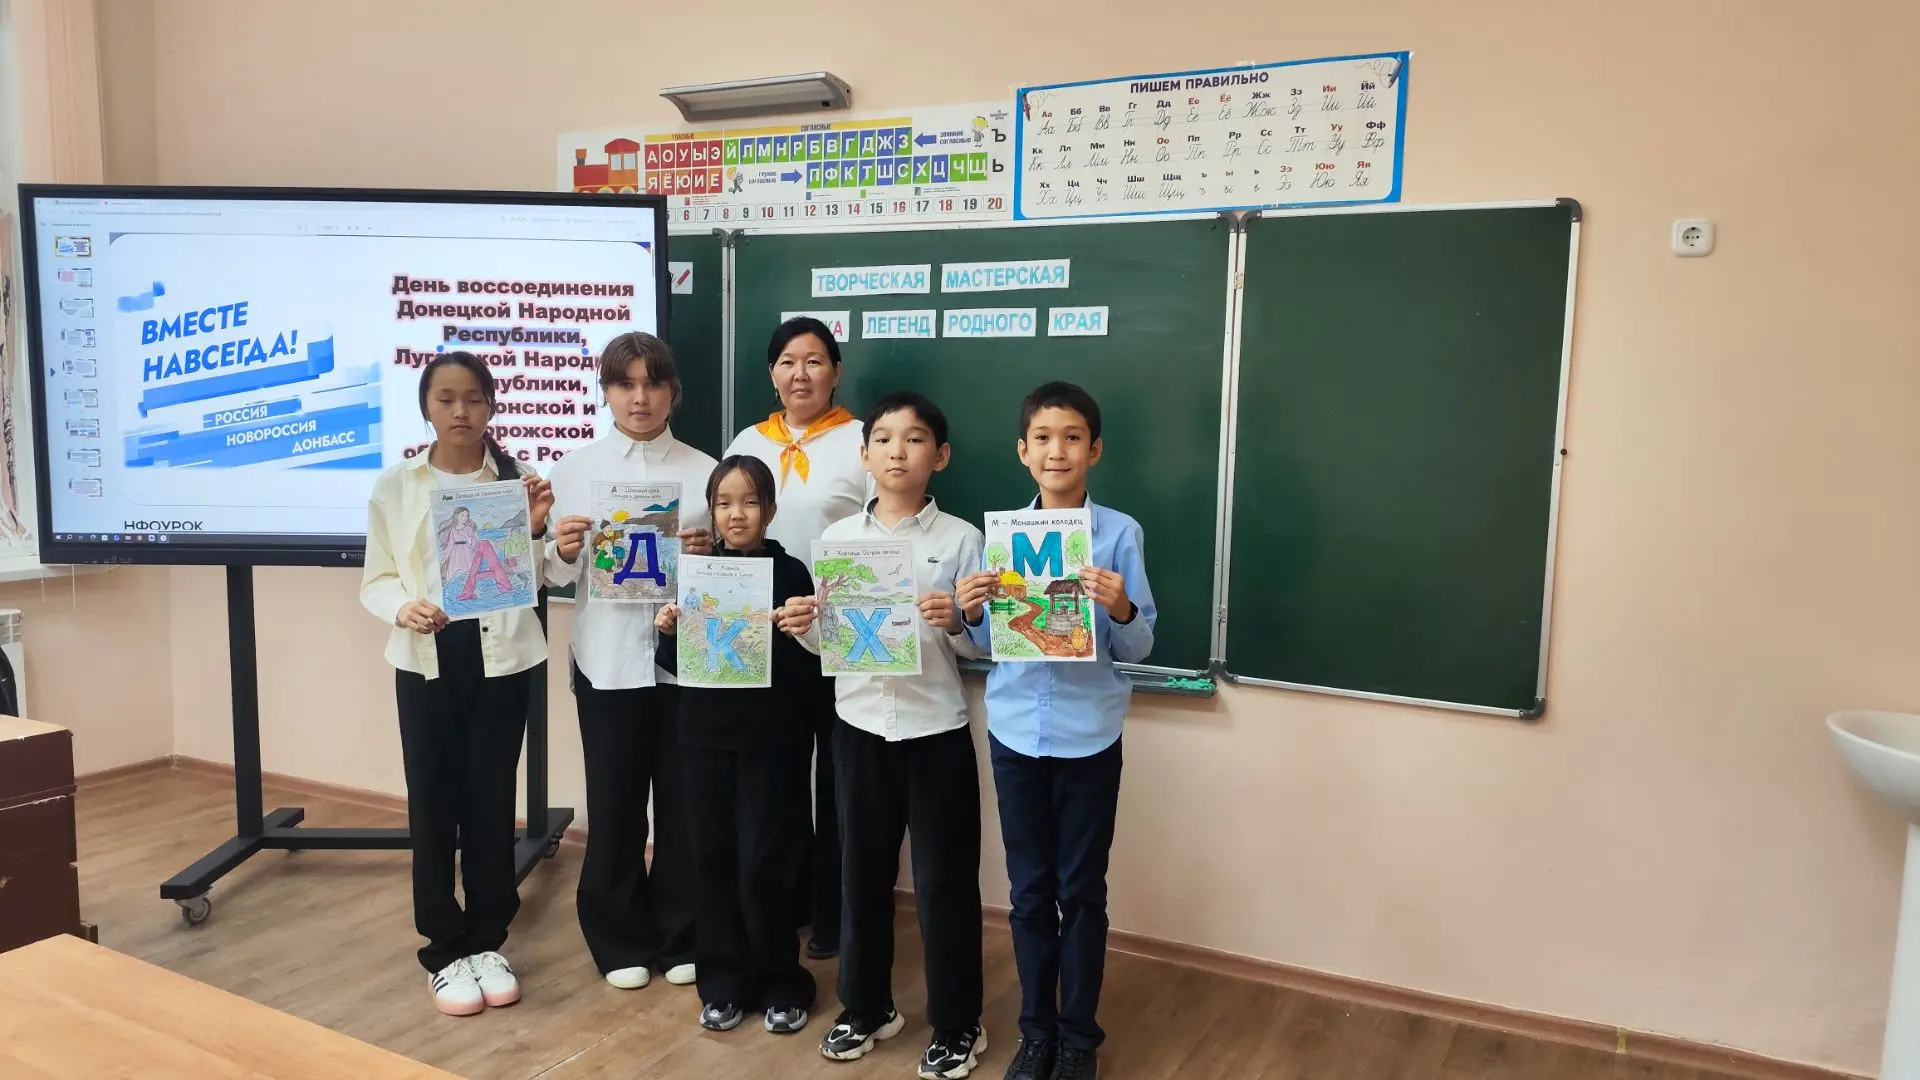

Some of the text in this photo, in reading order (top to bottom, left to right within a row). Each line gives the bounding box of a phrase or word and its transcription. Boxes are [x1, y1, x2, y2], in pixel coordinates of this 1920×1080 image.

[1130, 72, 1269, 93] ПИШЕМ ПРАВИЛЬНО
[1070, 108, 1082, 116] Бб
[1128, 102, 1137, 110] Гг
[1156, 100, 1171, 108] Дд
[1220, 94, 1231, 102] Ёё
[1252, 91, 1271, 99] Жж
[1290, 88, 1303, 96] Зз
[1323, 85, 1337, 93] Ии
[1361, 81, 1375, 90] Йй
[991, 128, 1007, 143] Ъ
[1090, 142, 1105, 150] Мм
[1157, 137, 1170, 145] Оо
[1229, 132, 1242, 140] Рр
[1260, 129, 1272, 137] Сс
[1294, 126, 1306, 134] Тт
[1330, 123, 1343, 132] Уу
[1365, 121, 1386, 132] Фф
[992, 159, 1004, 173] Ь
[1039, 182, 1050, 190] Хх
[1067, 180, 1081, 188] Цц
[1127, 175, 1145, 183] Шш
[1163, 173, 1182, 182] Щщ
[1280, 165, 1292, 173] Ээ
[1315, 162, 1335, 170] Юю
[1357, 160, 1371, 169] Яя
[683, 210, 690, 221] 6
[703, 209, 710, 220] 7
[722, 208, 729, 219] 8
[742, 207, 749, 218] 9
[761, 206, 774, 218] 10
[783, 206, 795, 217] 11
[804, 205, 816, 217] 12
[825, 204, 838, 216] 13
[847, 203, 860, 215] 14
[870, 202, 883, 214] 15
[892, 202, 906, 213] 16
[916, 201, 929, 213] 17
[939, 199, 953, 211] 18
[963, 198, 977, 210] 19
[987, 197, 1003, 209] 20
[392, 275, 635, 298] День воссоединения
[816, 265, 1066, 292] ТВОРЧЕСКАЯ МАСТЕРСКАЯ
[141, 301, 249, 346] ВМЕСТЕ
[397, 301, 631, 323] Донецкой Народной
[866, 316, 931, 336] ЛЕГЕНД
[948, 312, 1033, 335] РОДНОГО
[1053, 311, 1101, 331] КРАЯ
[443, 325, 587, 348] Республики,
[143, 330, 298, 382] НАВСЕГДА!
[394, 347, 517, 369] Лугкой
[215, 405, 268, 426] РОССИЯ
[583, 403, 596, 415] и
[226, 420, 317, 447] НОВОРОССИЯ
[292, 431, 356, 455] ДОНБАСС
[517, 449, 529, 461] с
[124, 520, 204, 531] НФОУРОК
[1011, 518, 1049, 527] Монашкин
[1051, 518, 1084, 526] колодец
[613, 533, 667, 587] Д
[1011, 532, 1064, 578] М
[455, 540, 515, 601] А
[706, 617, 749, 672] К
[842, 608, 895, 663] Х
